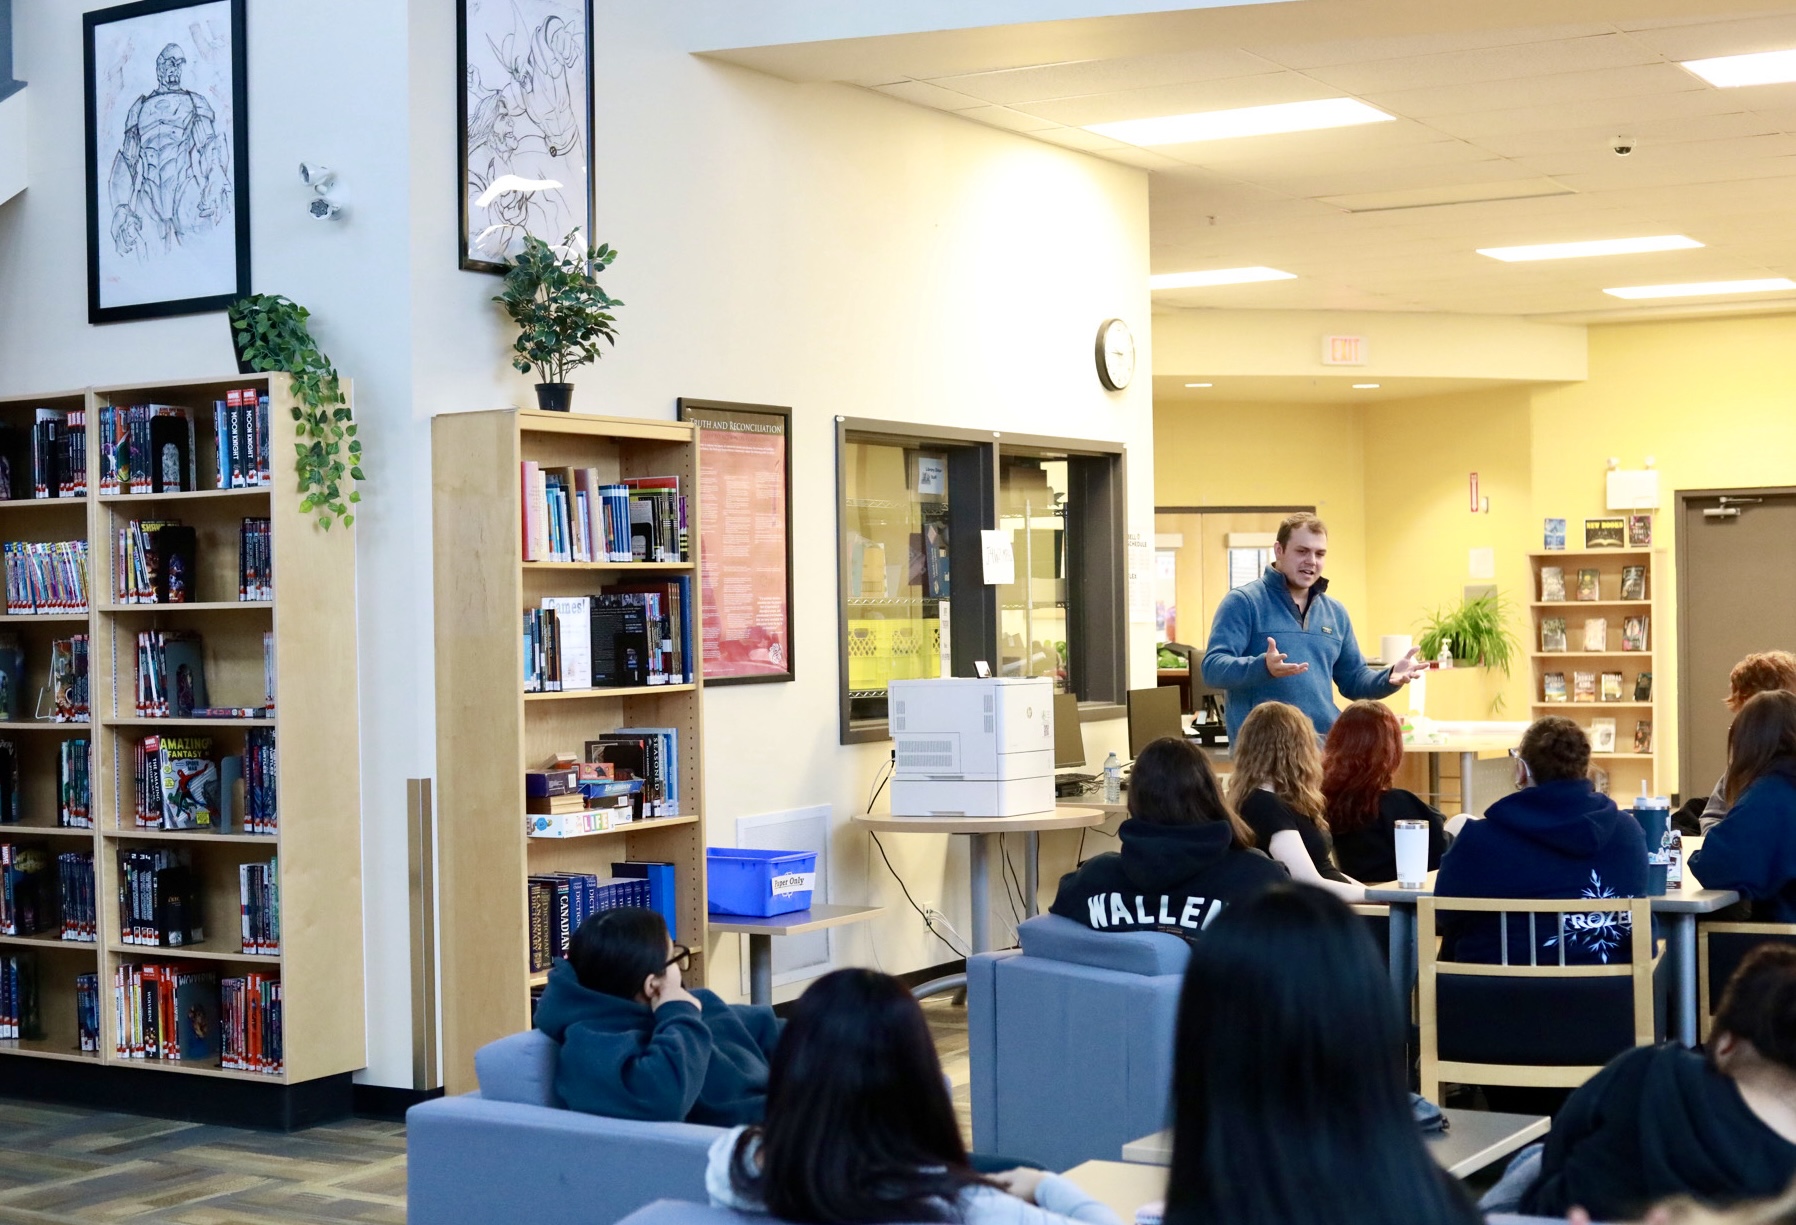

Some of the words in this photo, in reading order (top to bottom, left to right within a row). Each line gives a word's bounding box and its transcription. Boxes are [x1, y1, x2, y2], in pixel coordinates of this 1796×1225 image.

[1331, 337, 1360, 362] EXIT
[712, 420, 728, 430] AND
[729, 420, 782, 434] RECONCILIATION
[232, 433, 240, 460] KNIGHT
[1601, 521, 1624, 529] BOOKS
[548, 599, 586, 615] Games!
[160, 738, 209, 750] AMAZING
[582, 812, 609, 832] LIFE
[774, 880, 788, 888] Paper
[789, 876, 804, 886] Only
[560, 895, 570, 951] CANADIAN
